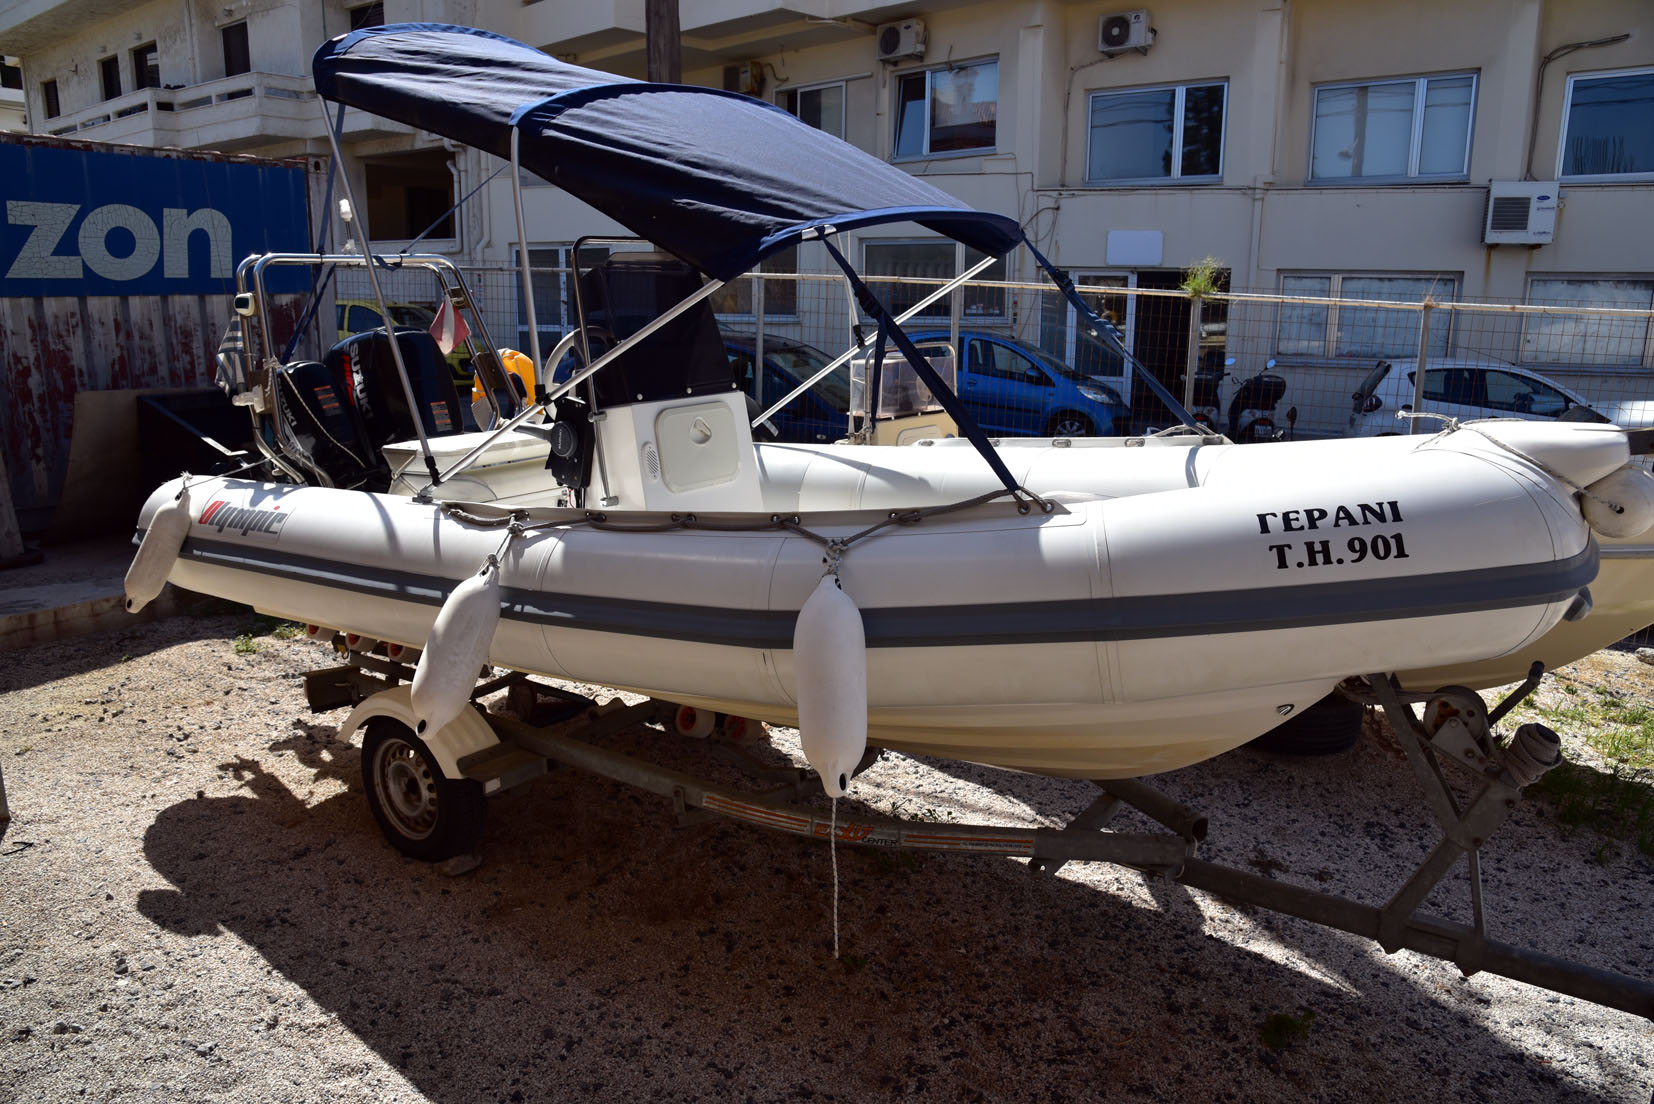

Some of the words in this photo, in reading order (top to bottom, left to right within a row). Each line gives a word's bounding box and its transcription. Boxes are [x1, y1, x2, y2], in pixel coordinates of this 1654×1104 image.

[5, 200, 233, 281] zon
[350, 342, 375, 420] SUZUKI
[198, 500, 288, 536] Olympic
[1256, 500, 1404, 534] ΓΕΡΑΝΙ
[862, 836, 898, 847] CENTER
